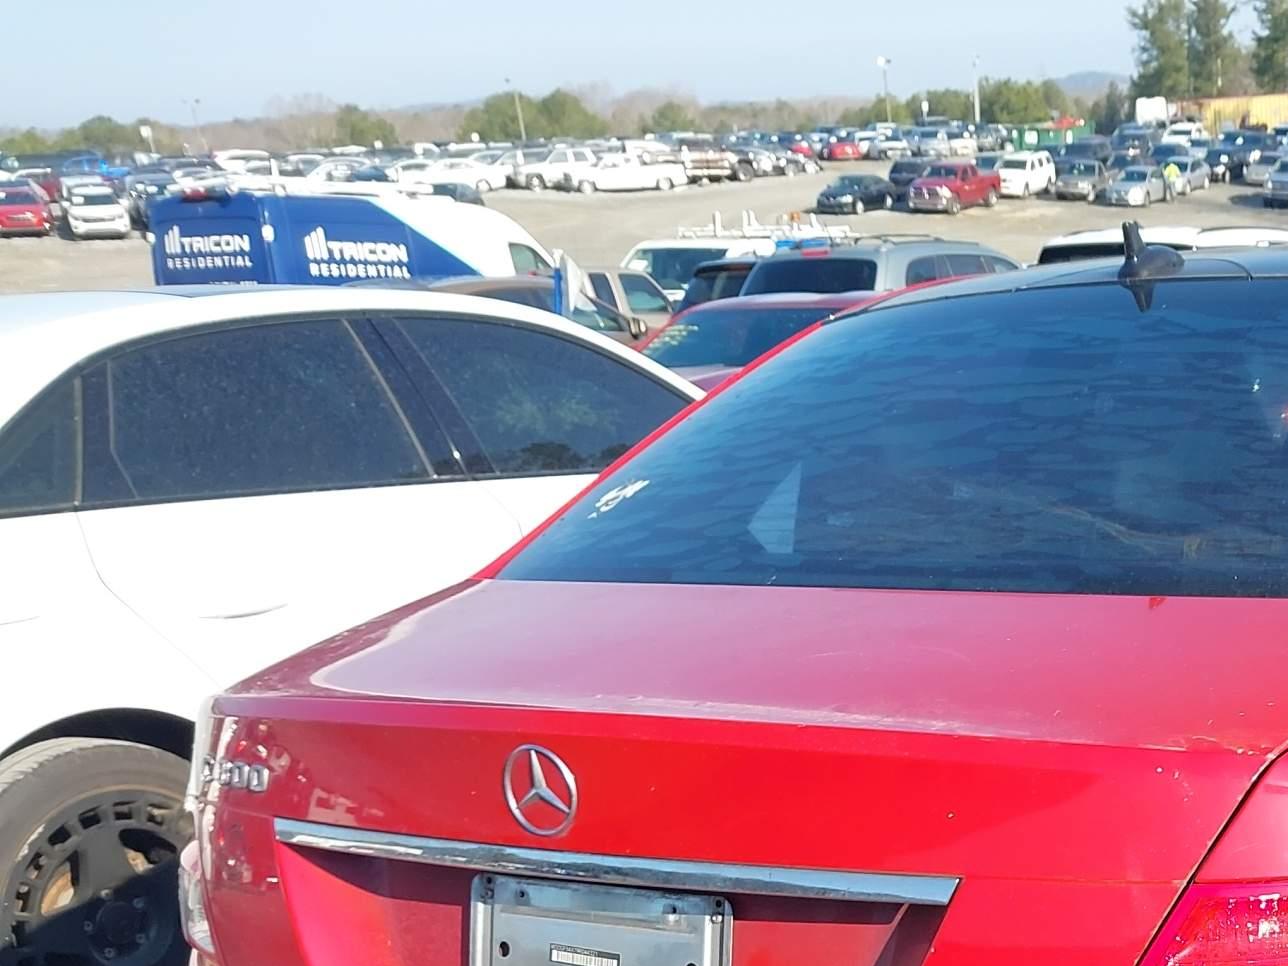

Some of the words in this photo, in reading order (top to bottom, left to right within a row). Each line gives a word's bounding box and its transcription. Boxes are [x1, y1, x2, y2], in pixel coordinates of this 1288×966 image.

[181, 234, 250, 254] TRICON
[327, 240, 408, 262] TRICON
[167, 255, 253, 270] RESIDENTIAL
[309, 262, 411, 280] RESIDENTIAL
